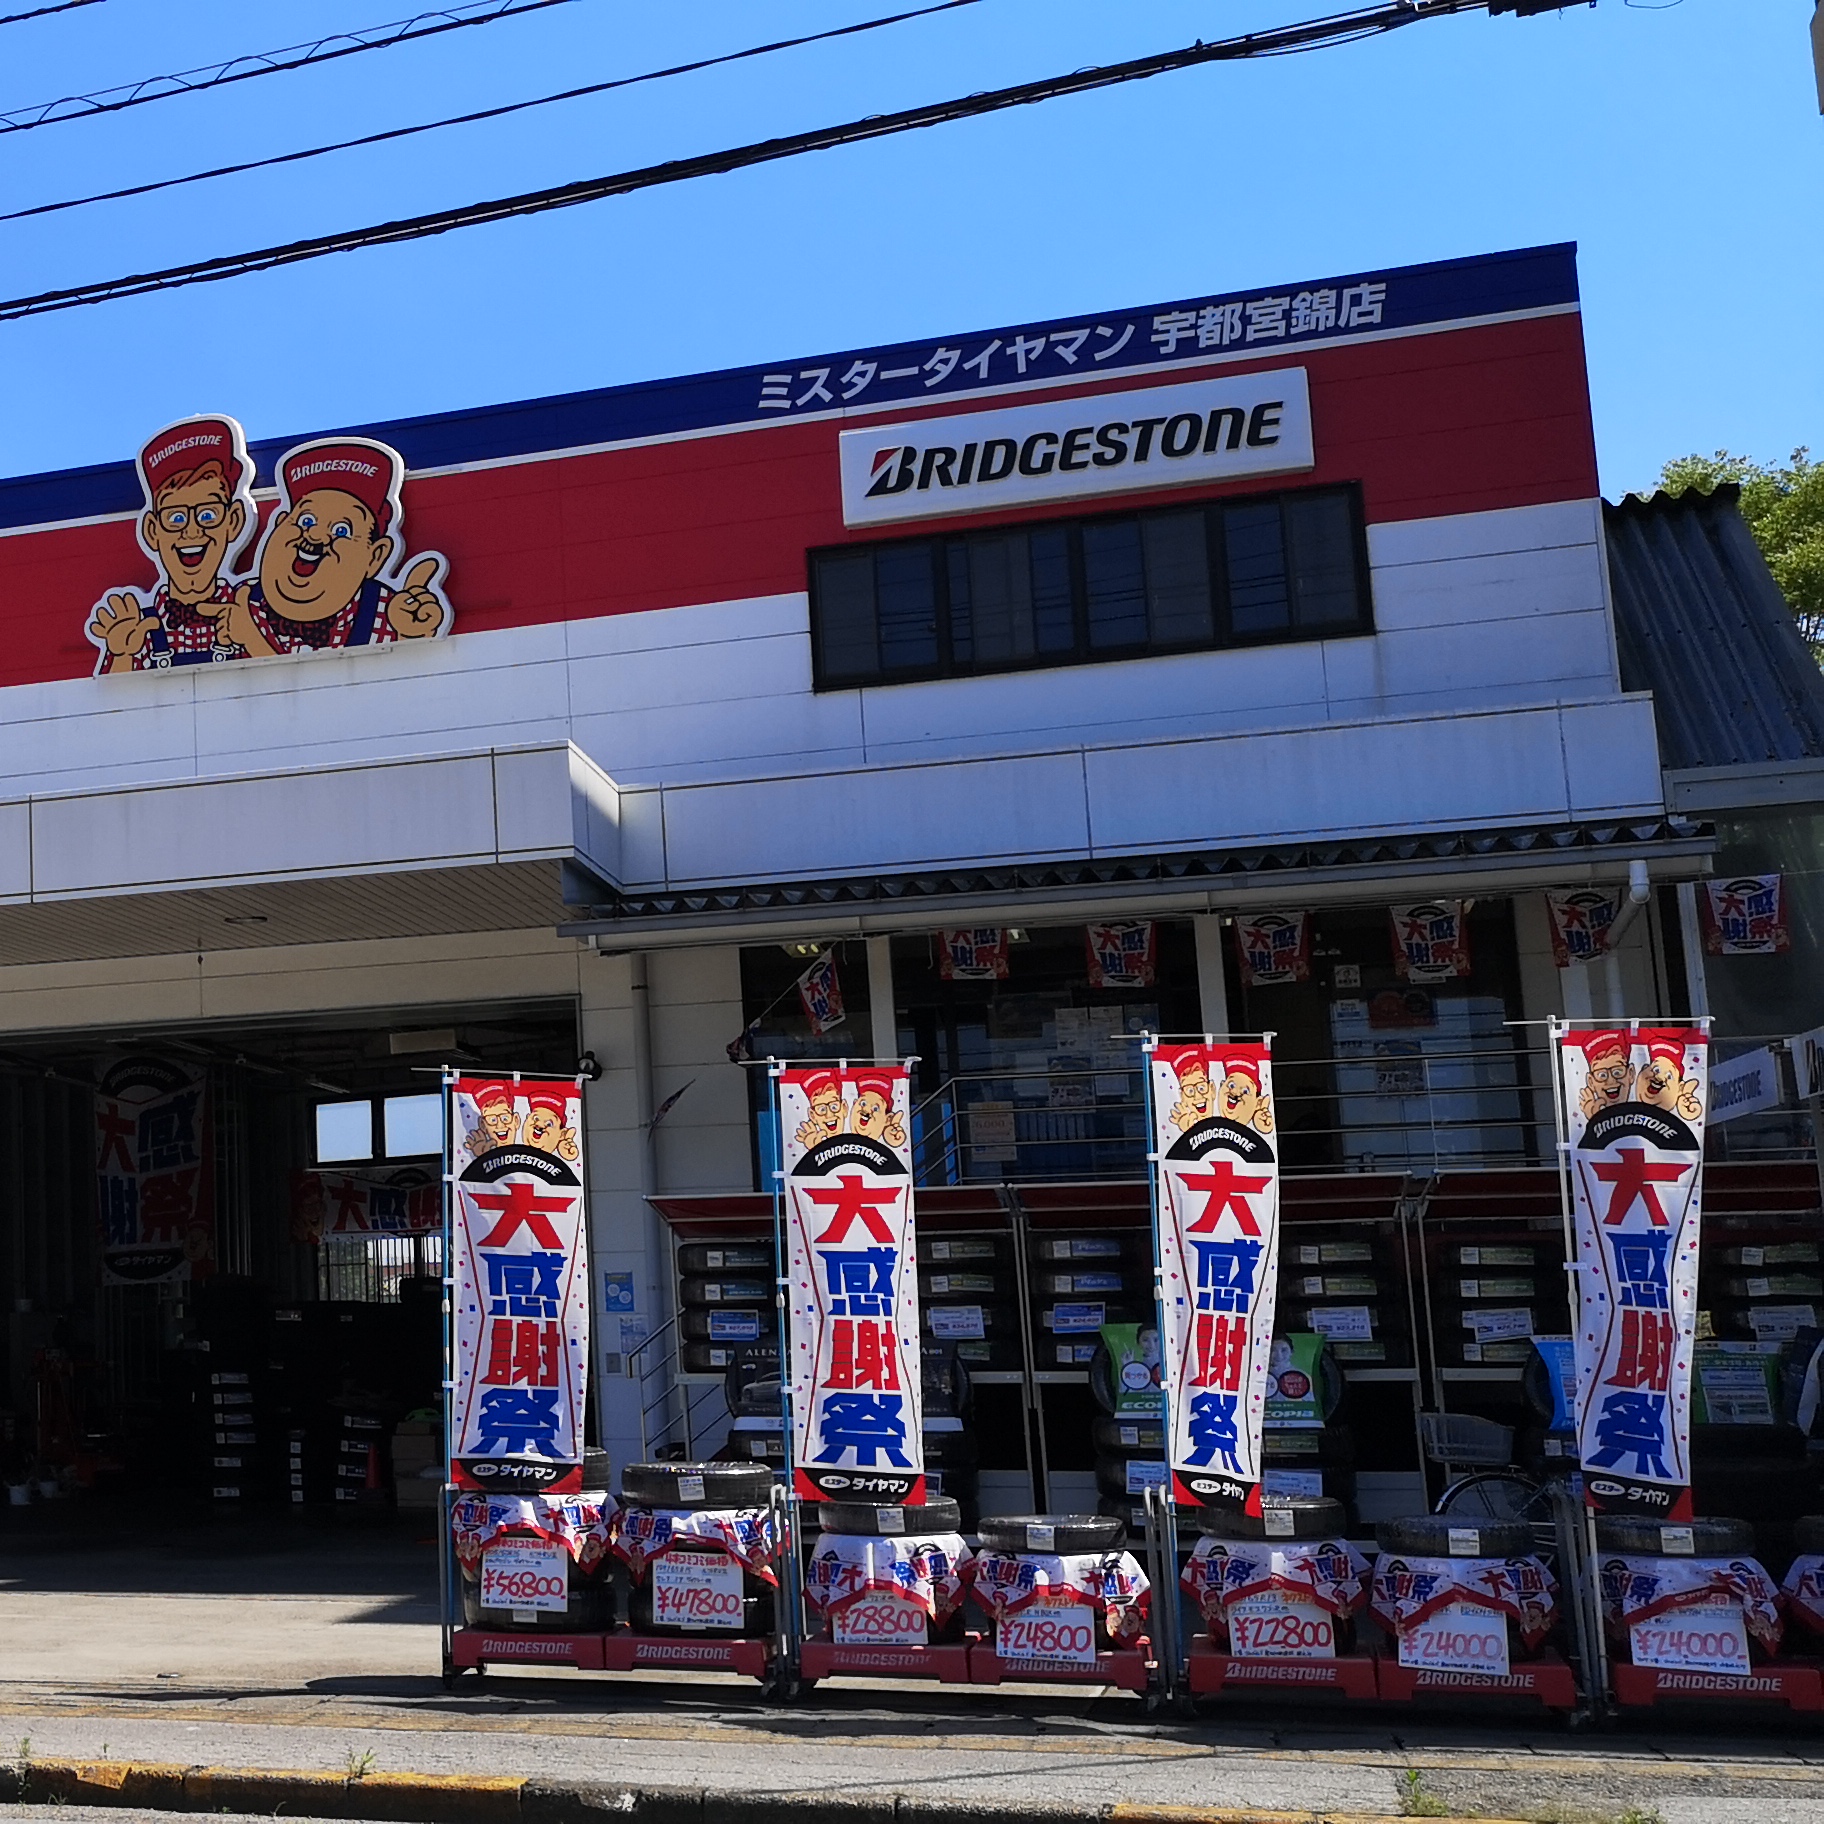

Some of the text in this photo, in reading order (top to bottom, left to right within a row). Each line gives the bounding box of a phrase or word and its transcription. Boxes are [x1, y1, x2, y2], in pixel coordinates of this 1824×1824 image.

[757, 281, 1387, 411] ミスタータイヤマン 宇都宮錦店
[149, 435, 223, 468] BRIDGESTONE
[864, 400, 1284, 498] BRIDGESTONE
[290, 459, 380, 483] BRIDGESTONE
[1593, 1113, 1678, 1139] BRIDGESTONE
[1189, 1127, 1257, 1153] BRIDGESTONE
[482, 1154, 562, 1177] BRIDGESTONE
[815, 1144, 887, 1167] BRIDGESTONE
[467, 1182, 577, 1458] 大感謝祭
[802, 1175, 913, 1467] 大感謝祭
[1176, 1161, 1272, 1476] 大感謝祭
[1586, 1148, 1693, 1480] 大感謝祭
[499, 1464, 557, 1480] タイヤマン
[852, 1477, 909, 1493] タイヤマン
[482, 1639, 574, 1655] BRIDGESTONE
[635, 1643, 733, 1661] BRIDGESTONE
[1224, 1662, 1338, 1681] BRIDGESTONE
[1415, 1670, 1536, 1688] BRIDGESTONE
[1657, 1672, 1783, 1692] BRIDGESTONE
